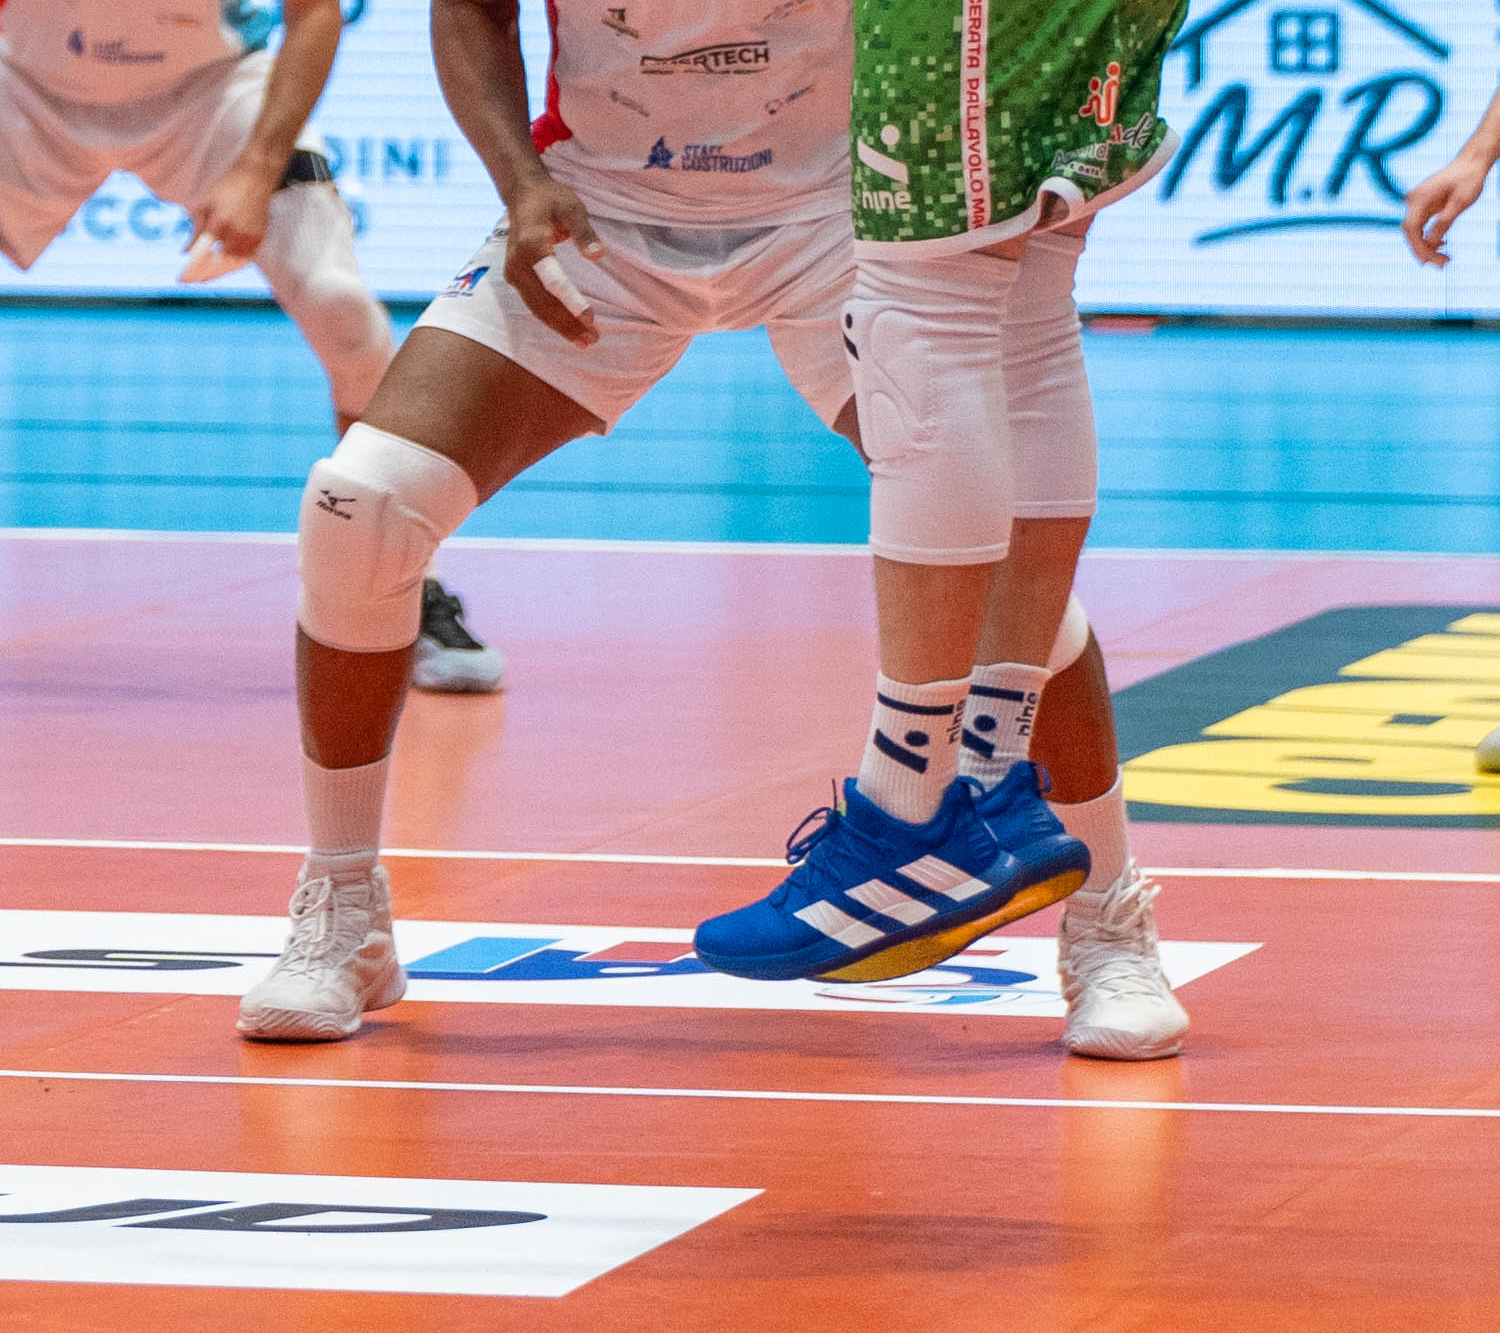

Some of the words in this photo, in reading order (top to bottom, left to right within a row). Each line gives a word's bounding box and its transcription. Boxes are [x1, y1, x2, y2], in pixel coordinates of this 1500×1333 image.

[964, 76, 989, 195] PALLAVOLO
[1158, 69, 1447, 207] M.R
[861, 187, 913, 213] nine
